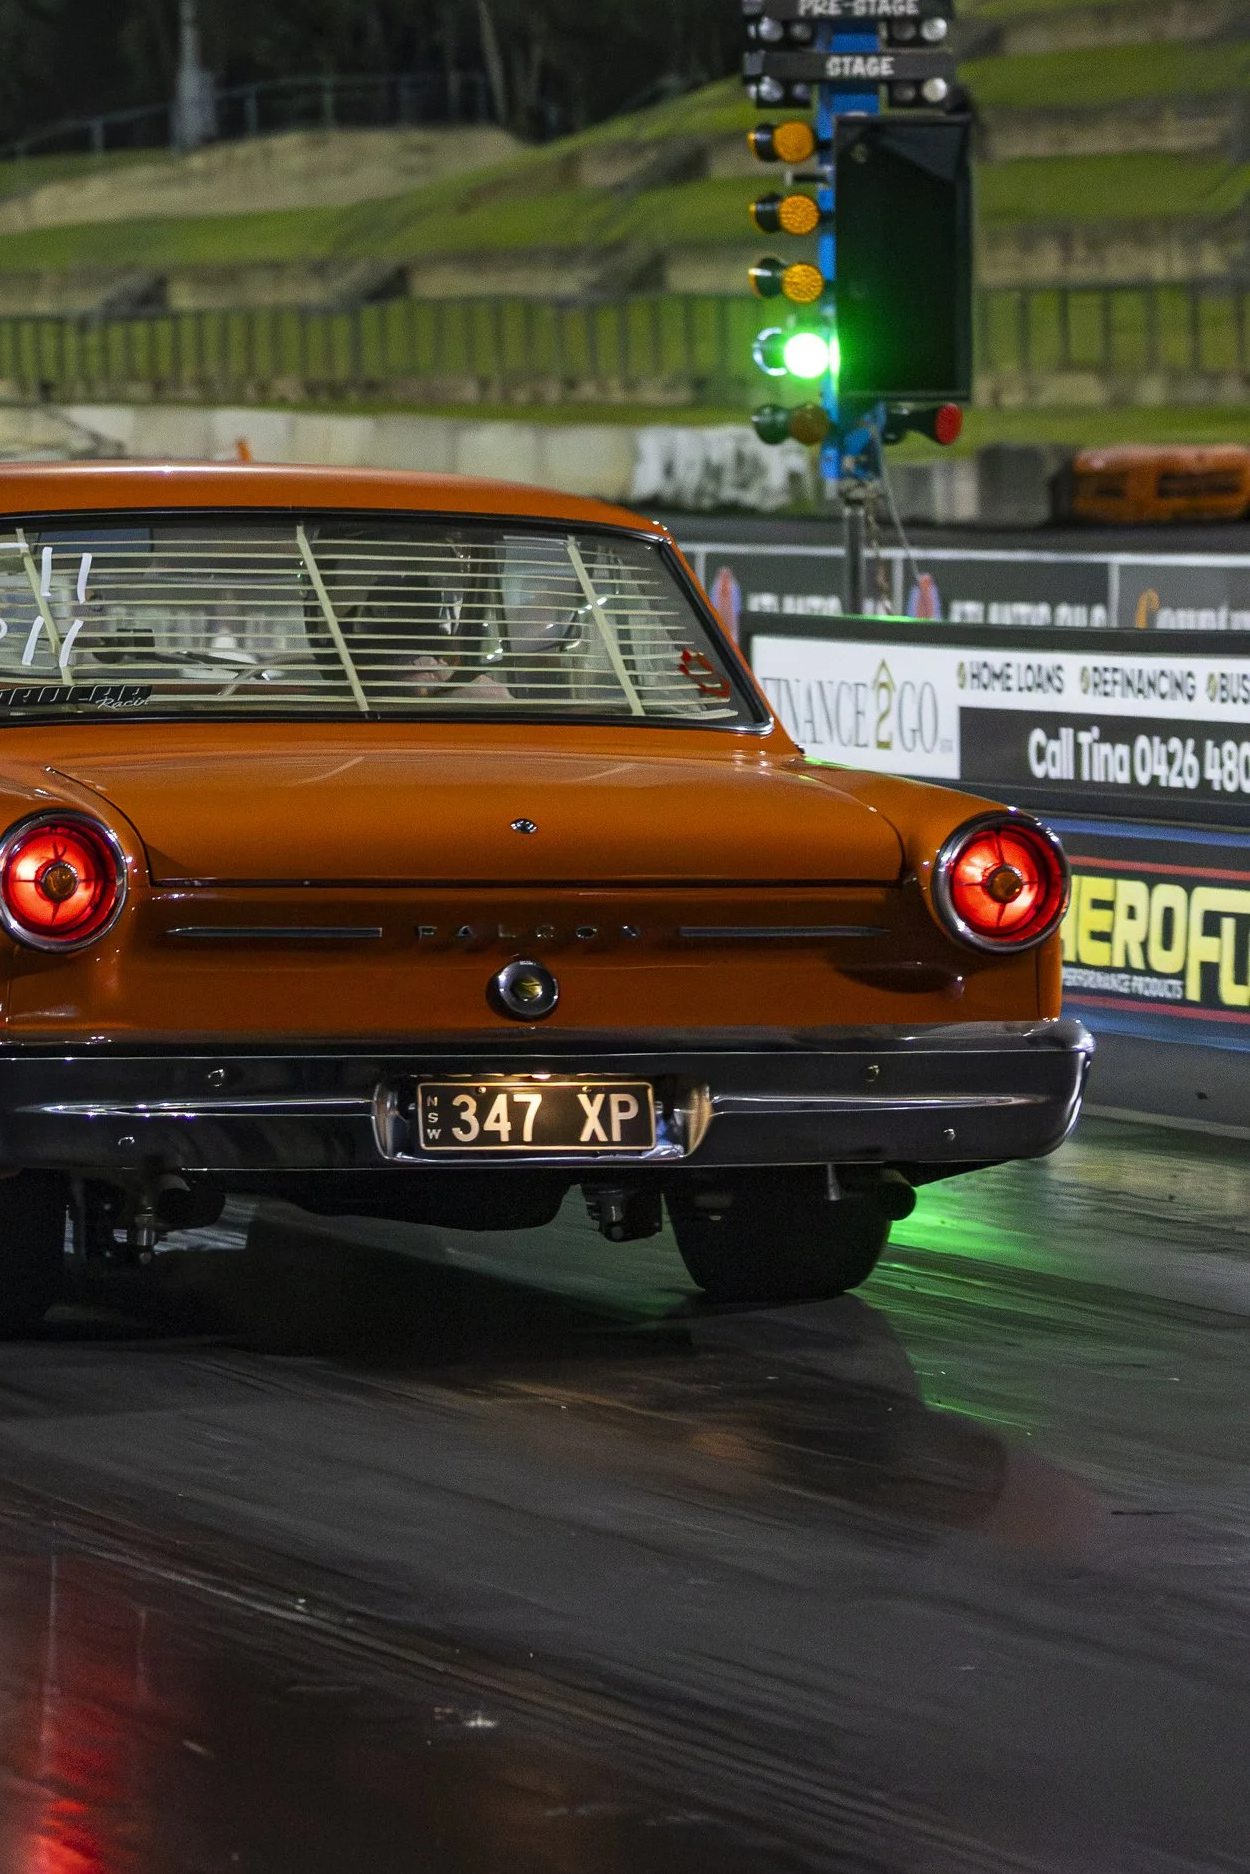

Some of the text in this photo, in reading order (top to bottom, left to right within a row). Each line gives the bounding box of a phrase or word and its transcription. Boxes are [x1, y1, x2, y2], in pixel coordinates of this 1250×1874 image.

[825, 55, 895, 76] STAGE
[970, 661, 1013, 692] HOME
[1017, 664, 1065, 695] LOANS
[1092, 666, 1196, 703] REFINANCING
[1028, 726, 1250, 793] Call Tina 0426 480
[452, 1093, 639, 1142] 347 XP
